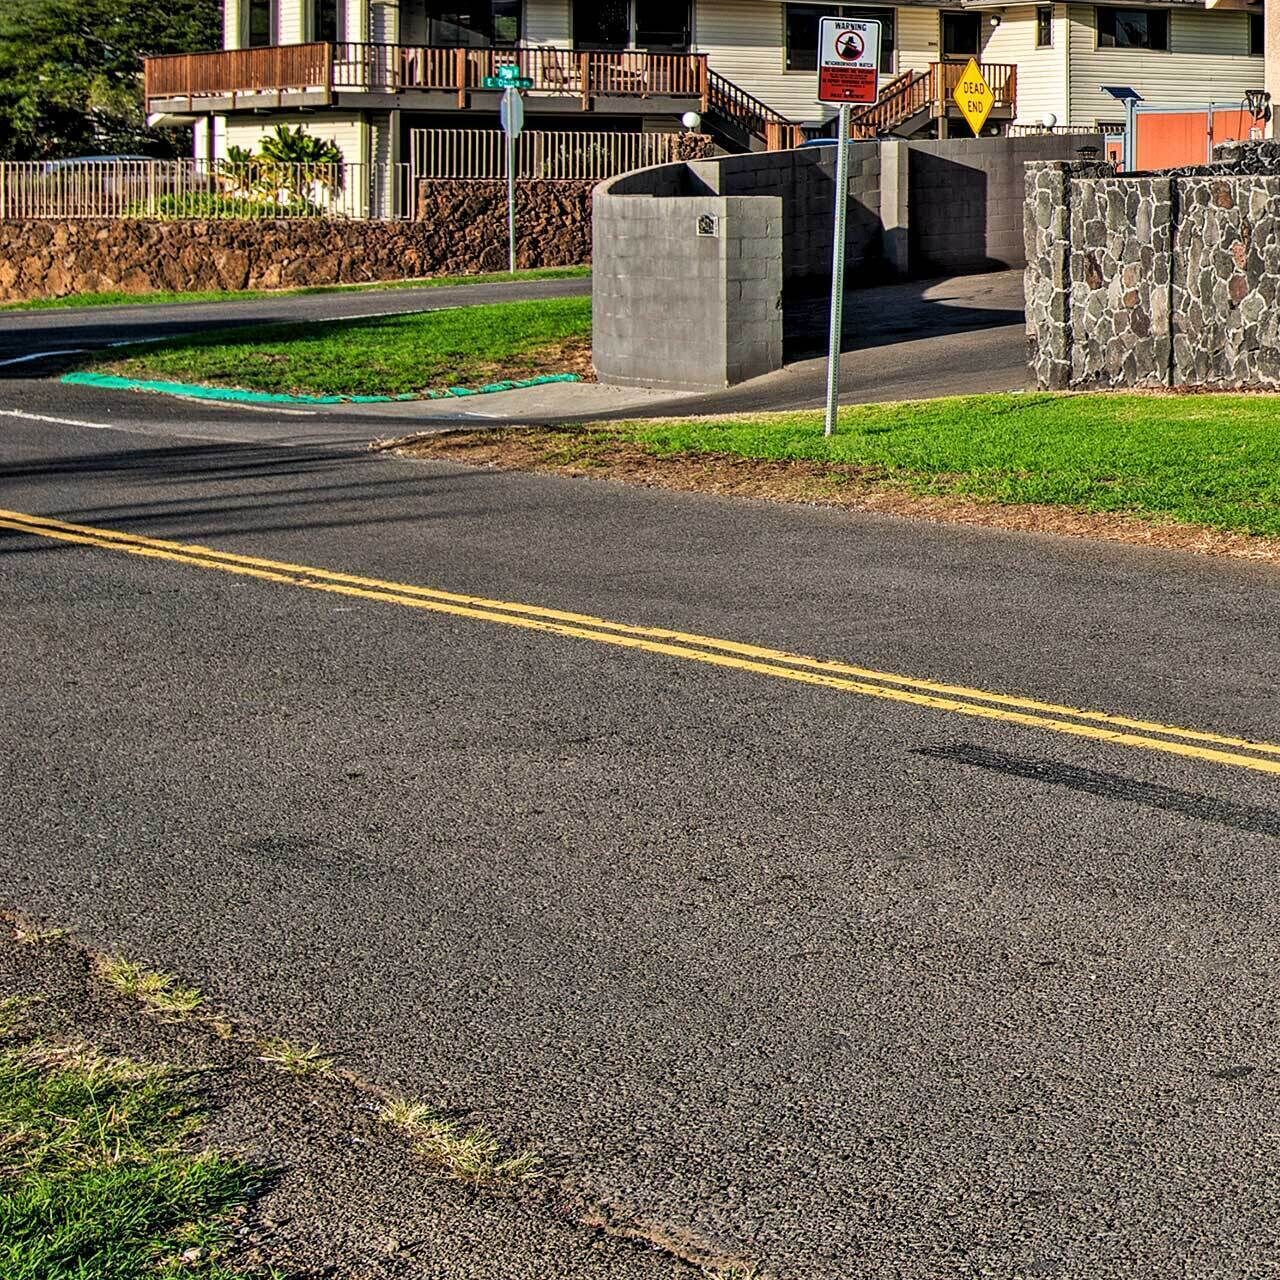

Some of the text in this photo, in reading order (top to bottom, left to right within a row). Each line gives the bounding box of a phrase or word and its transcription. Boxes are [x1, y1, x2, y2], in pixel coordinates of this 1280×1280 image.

[835, 22, 867, 31] WARNING
[964, 81, 984, 94] DEAD
[968, 100, 983, 113] END
